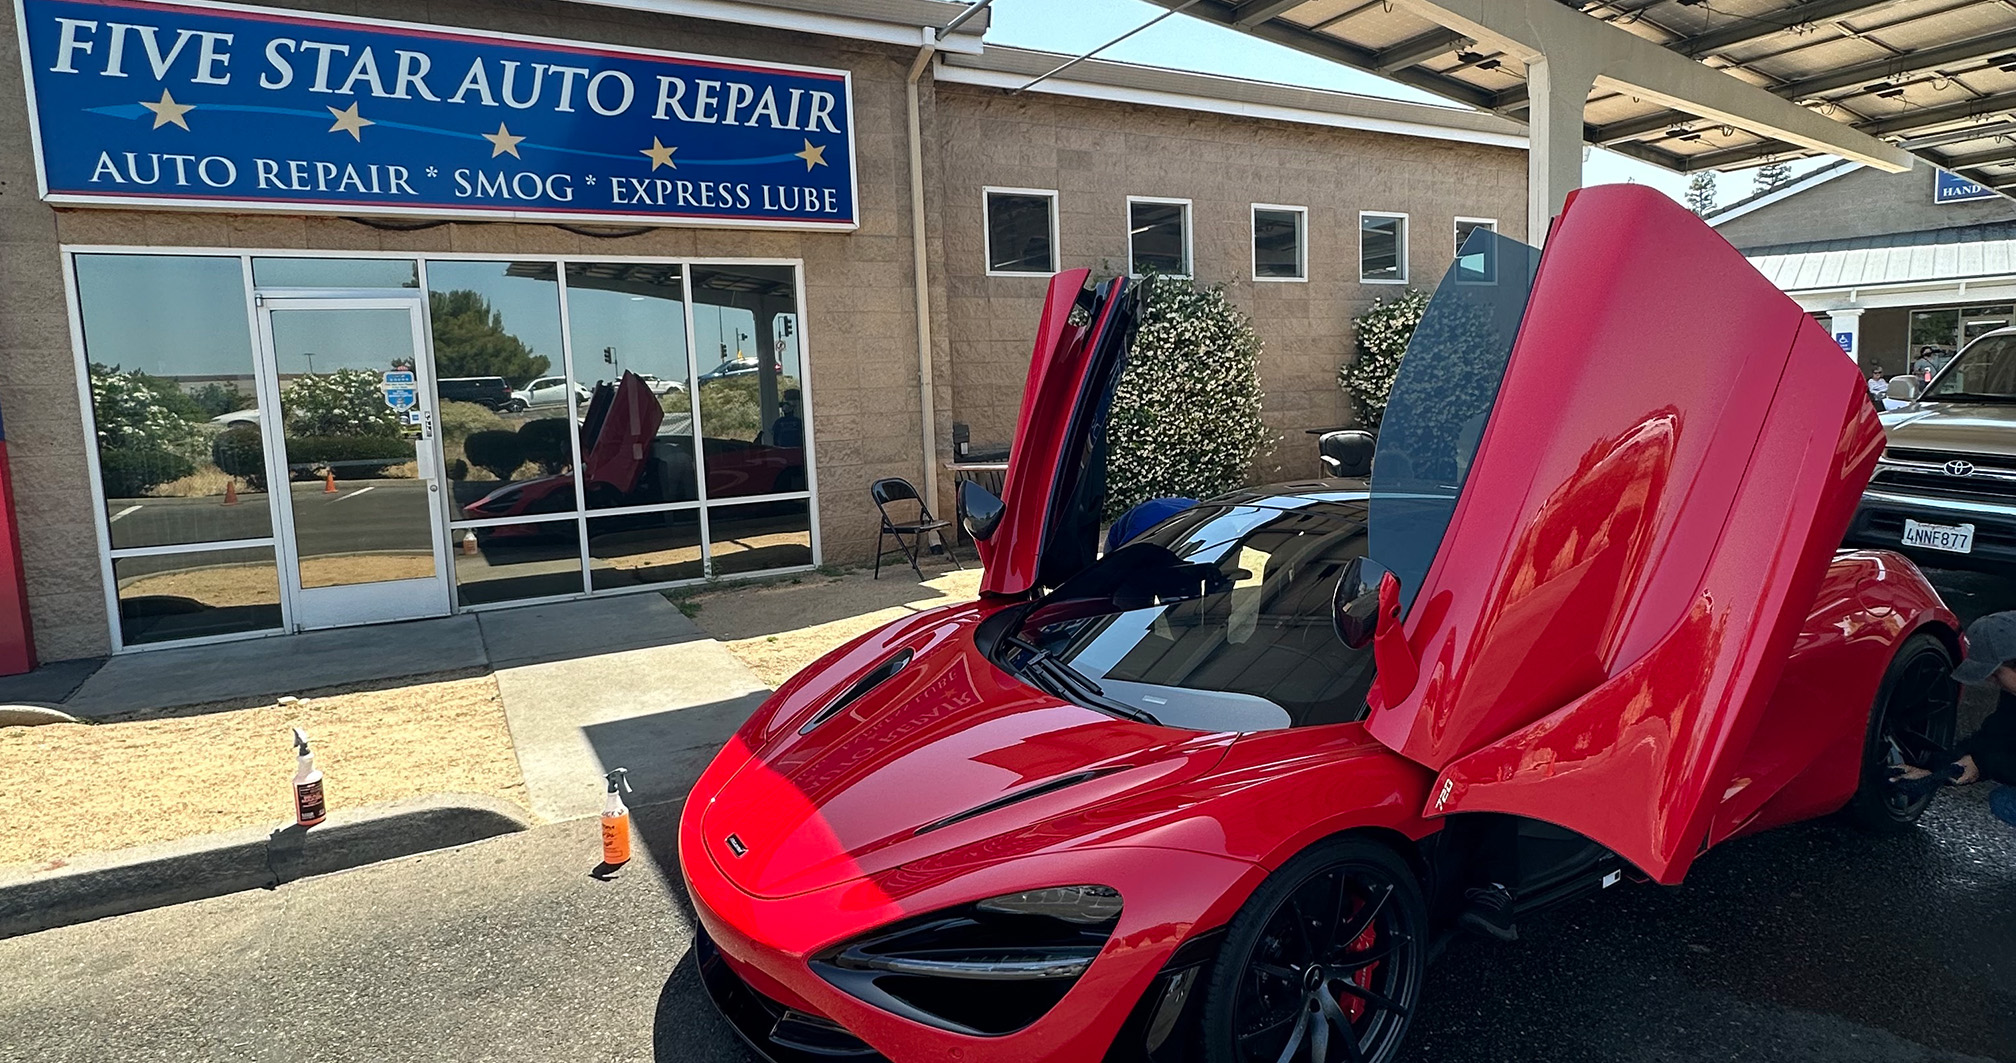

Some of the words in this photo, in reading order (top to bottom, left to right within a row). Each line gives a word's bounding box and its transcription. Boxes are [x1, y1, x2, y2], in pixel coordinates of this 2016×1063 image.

[49, 17, 234, 85] FIVE
[260, 37, 441, 102] STAR
[446, 56, 635, 116] AUTO
[652, 75, 842, 134] REPAIR
[89, 150, 237, 188] AUTO
[254, 158, 419, 195] REPAIR
[454, 168, 574, 202] SMOG
[610, 177, 751, 209] EXPRESS
[762, 184, 838, 213] LUBE
[1943, 184, 1981, 197] HAND
[1906, 527, 1968, 549] 4NNF877
[1434, 778, 1454, 812] 720
